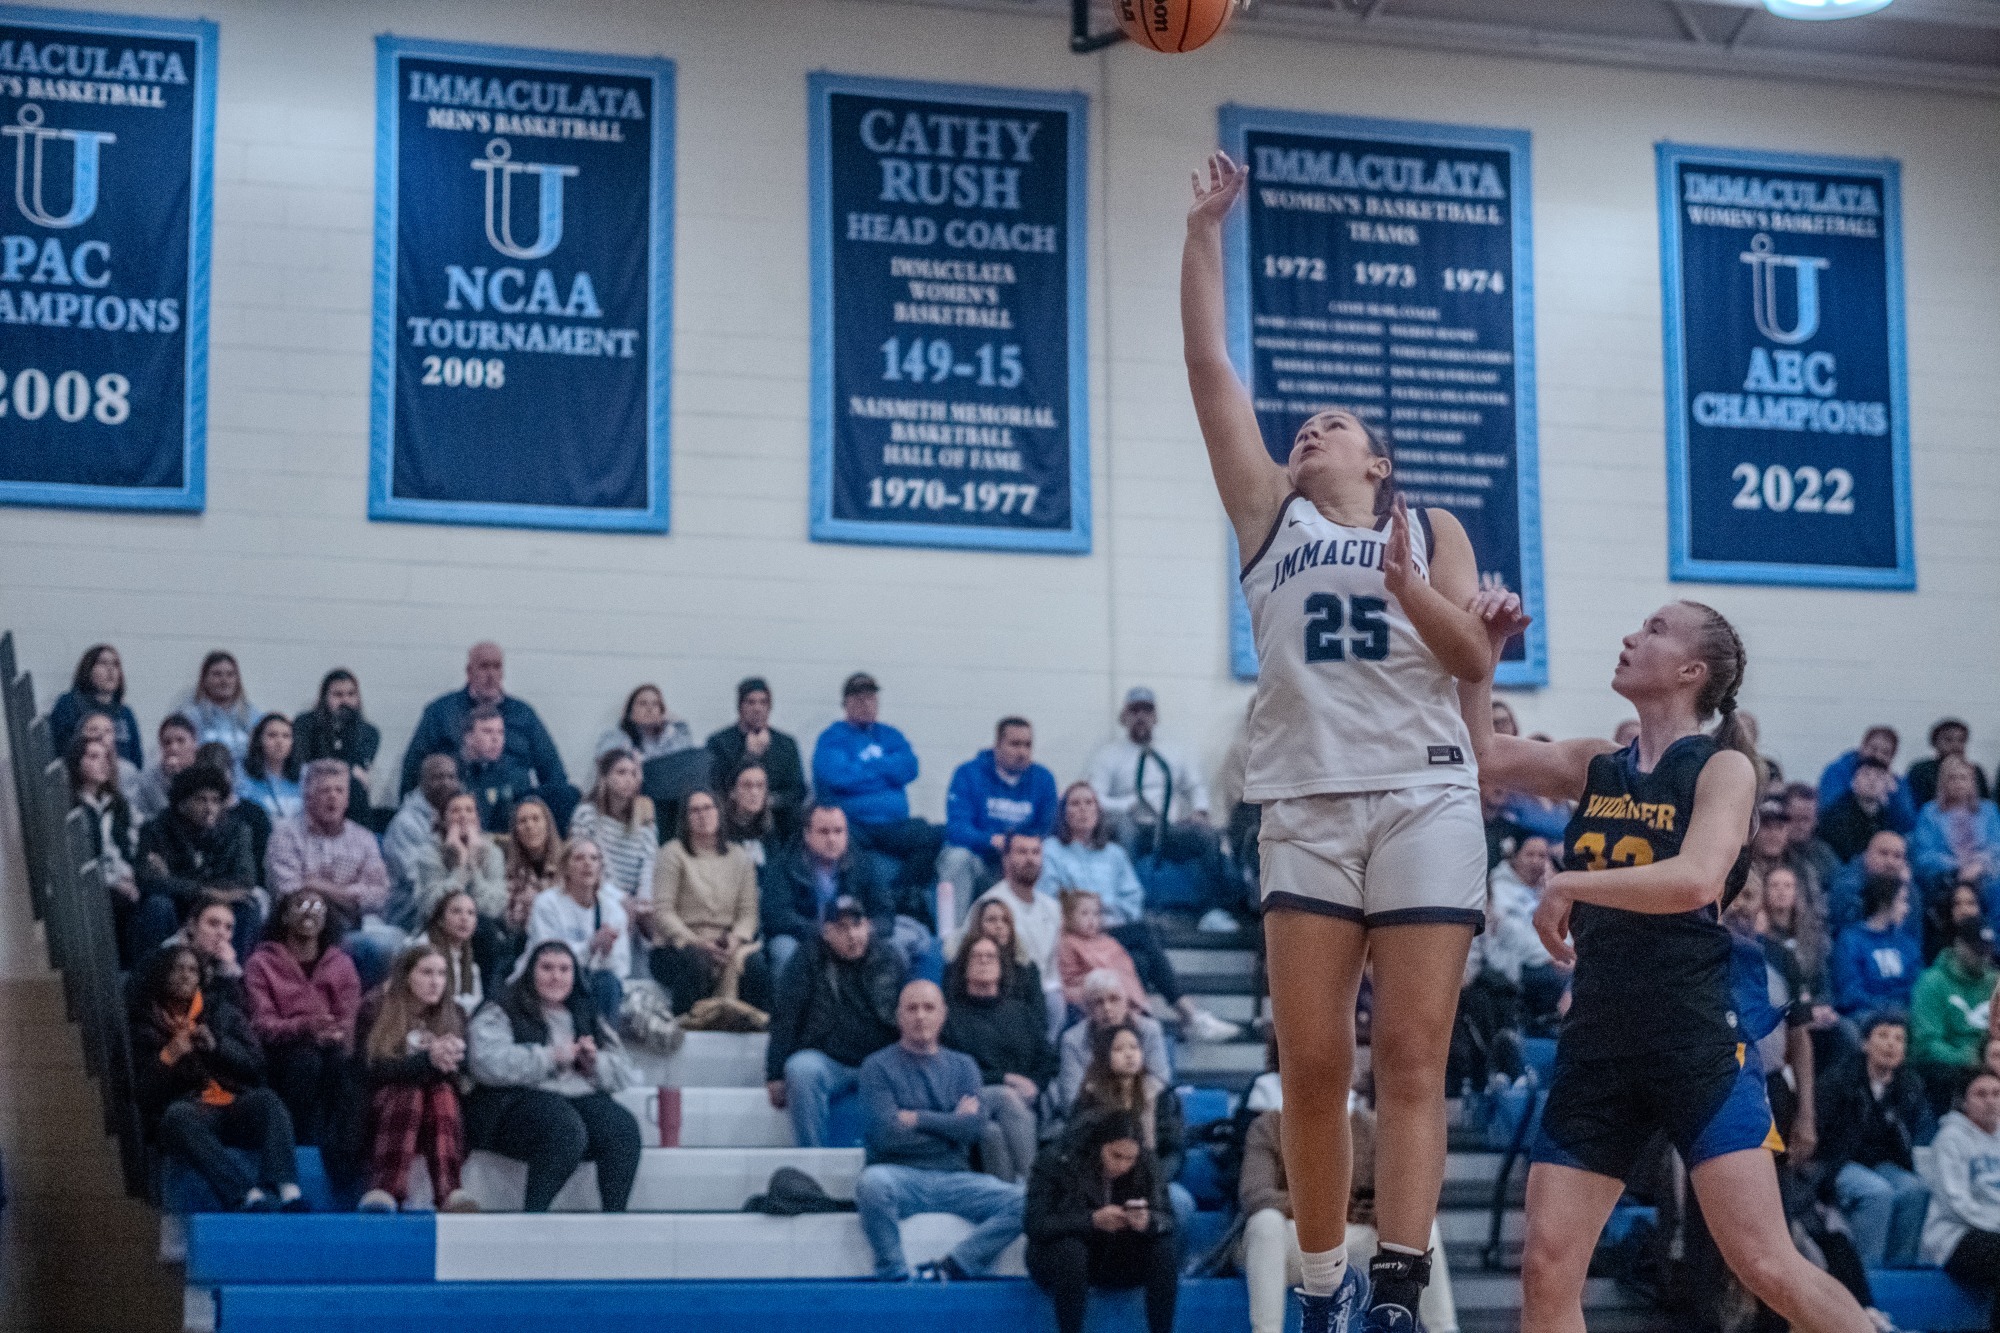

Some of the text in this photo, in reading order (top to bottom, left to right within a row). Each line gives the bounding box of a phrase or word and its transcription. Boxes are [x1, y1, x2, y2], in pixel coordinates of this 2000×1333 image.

[1154, 0, 1169, 32] on
[27, 77, 167, 108] BASKETBALL
[408, 71, 645, 120] IMMACULATA
[427, 107, 625, 142] MEN'S BASKETBALL
[860, 109, 1041, 162] CATHY
[878, 158, 1021, 209] RUSH
[1254, 145, 1506, 199] IMMACULATA
[1260, 188, 1504, 226] WOMEN'S BASKETBALL
[1684, 172, 1880, 217] IMMACULATA
[847, 212, 1057, 253] HEAD COACH
[1346, 220, 1420, 246] TEAMS
[1687, 205, 1878, 239] WOMEN'S BASKETBALL
[0, 235, 111, 288] PAC
[891, 256, 1017, 283] IMMACULATA
[1263, 254, 1505, 295] 1972 1973 1974
[444, 265, 603, 318] NCAA
[908, 280, 1000, 305] WOMEN'S
[893, 302, 1014, 329] BASKETBALL
[407, 317, 639, 358] TOURNAMENT
[421, 355, 505, 389] 2008
[880, 336, 1023, 388] 149-15
[1743, 346, 1838, 398] AEC
[0, 368, 131, 426] 008
[950, 402, 1057, 428] MEMORIAL
[1692, 391, 1889, 437] CHAMPIONS
[891, 421, 1014, 448] BASKETBALL
[883, 444, 1022, 471] HALL OF FAME
[868, 476, 1040, 515] 1970-1977
[1731, 462, 1855, 515] 2022
[1304, 591, 1391, 664] 25
[1583, 794, 1677, 832] WIDENER
